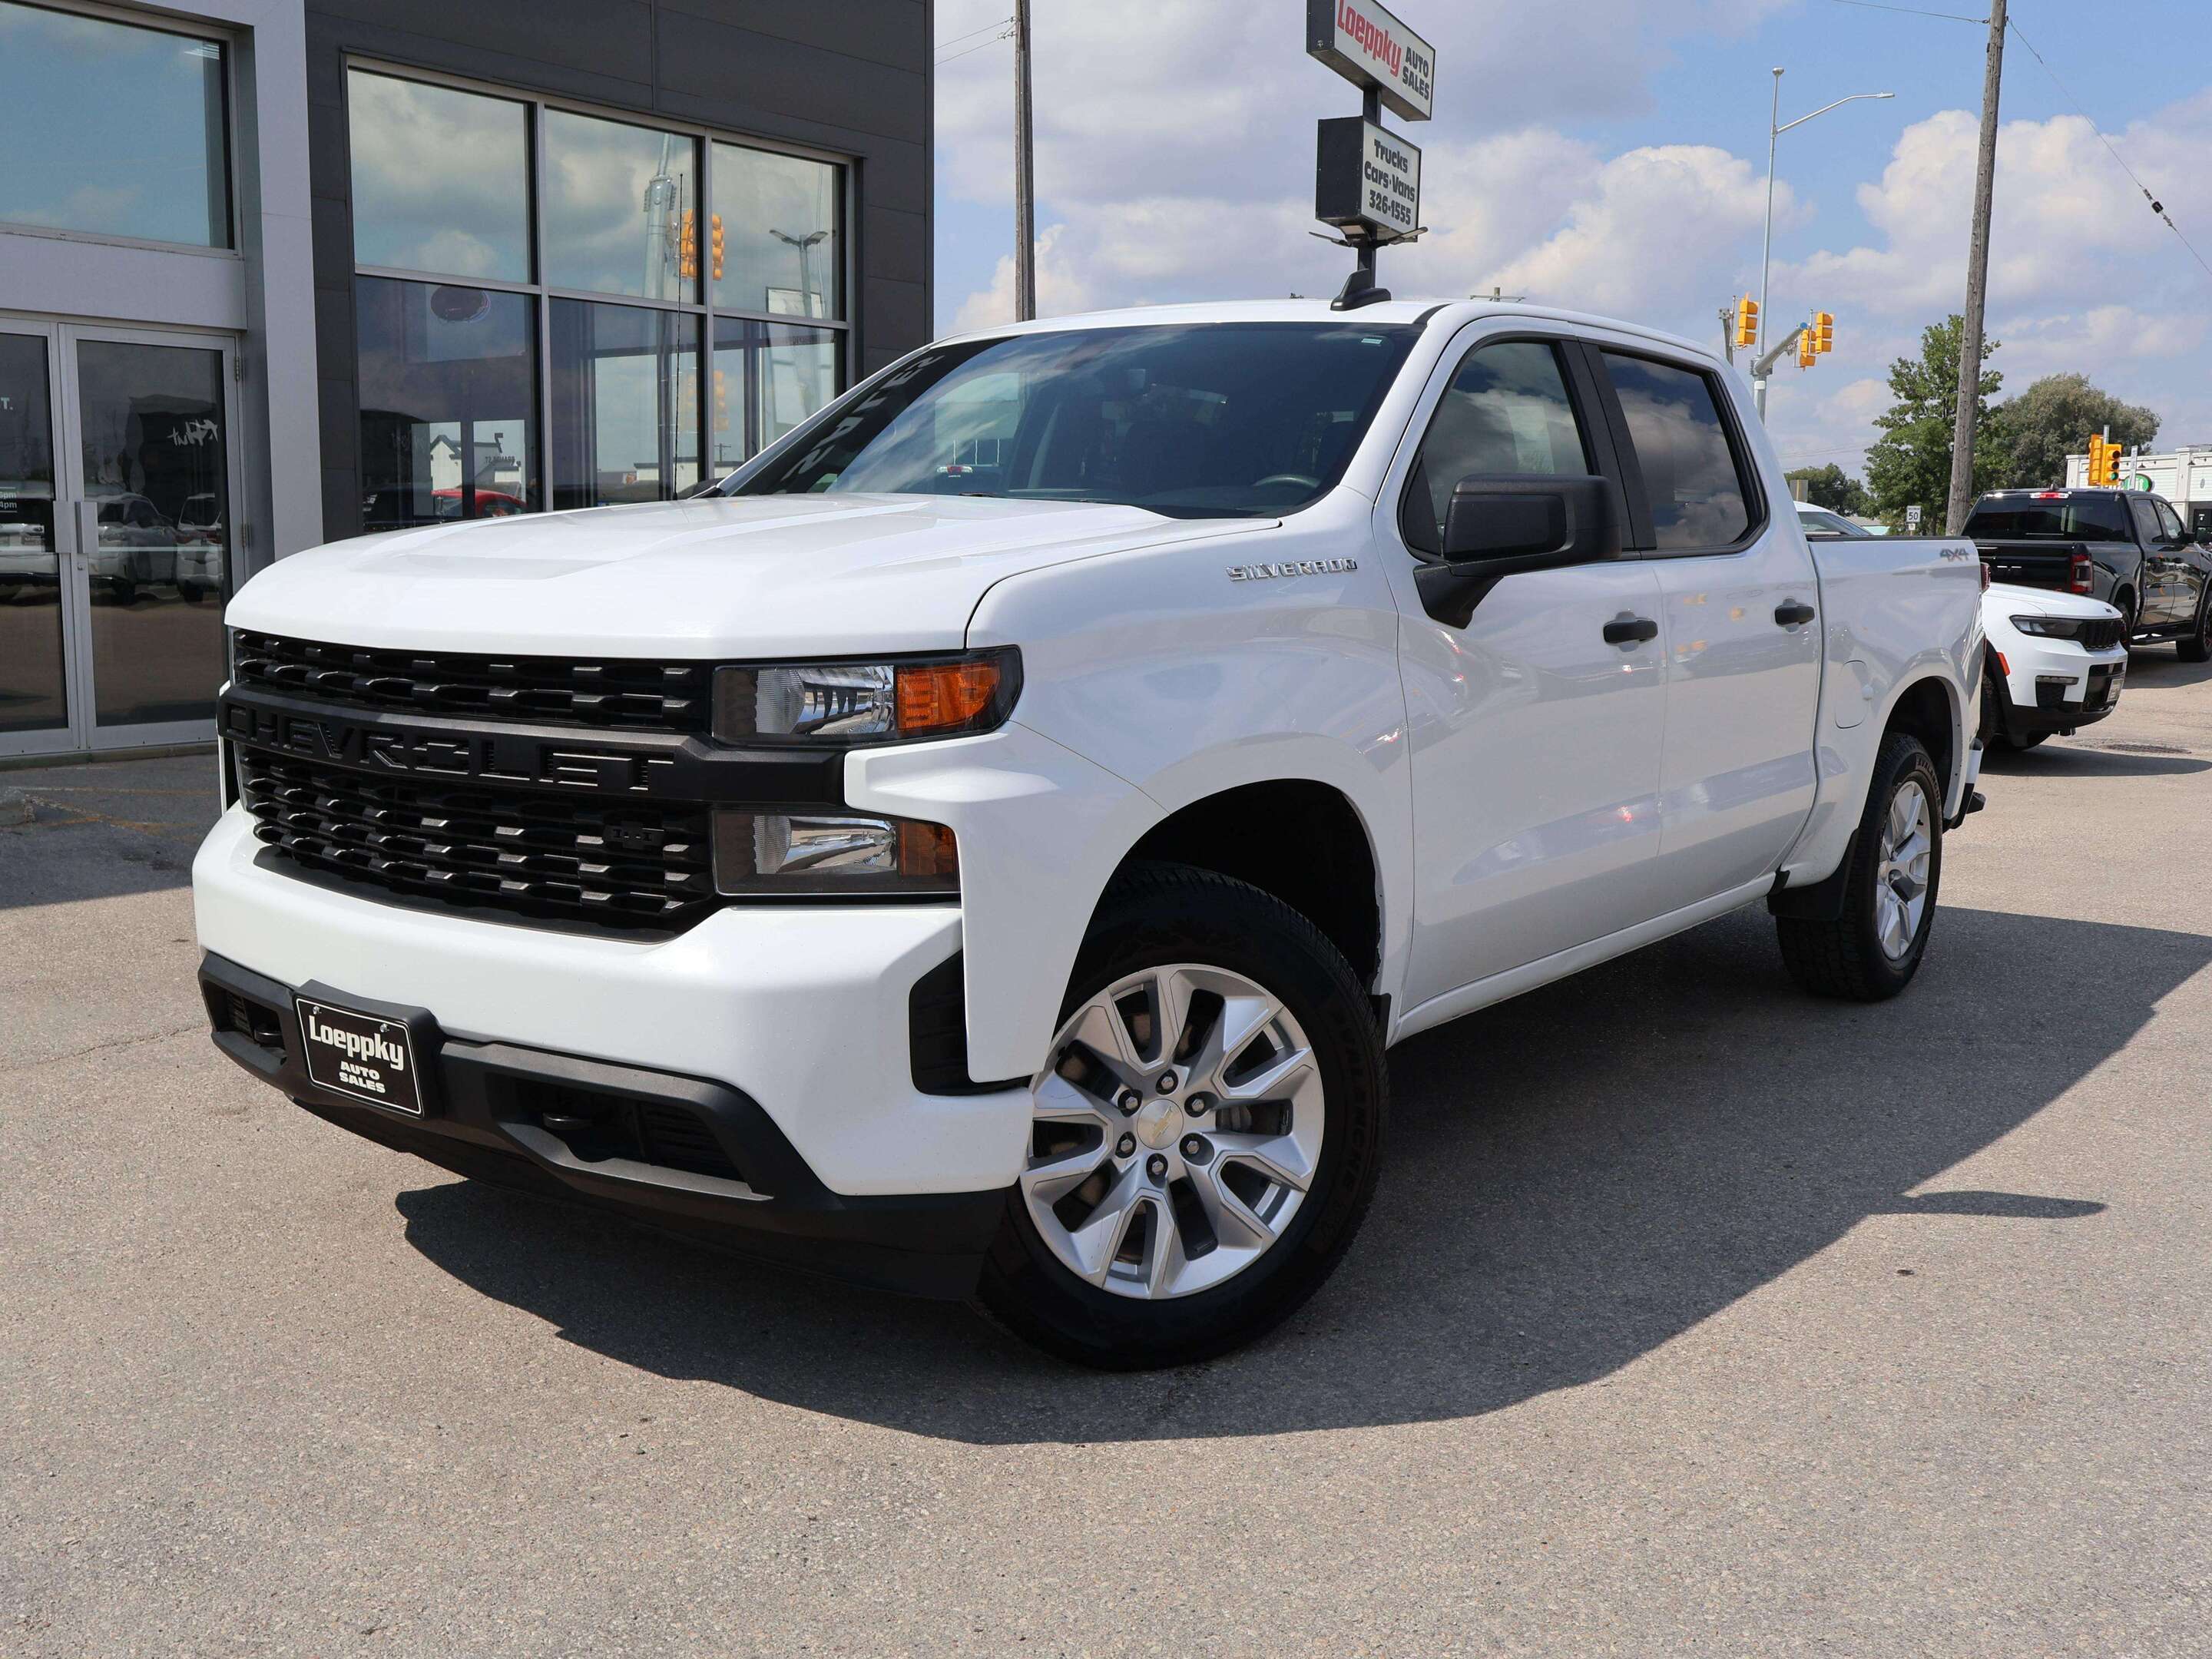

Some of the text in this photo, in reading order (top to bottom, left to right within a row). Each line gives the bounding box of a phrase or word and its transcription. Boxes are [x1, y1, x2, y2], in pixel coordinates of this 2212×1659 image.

[1337, 0, 1402, 78] Loeppky
[1405, 46, 1429, 78] AUTO
[1402, 66, 1430, 101] SALES
[1374, 138, 1408, 174] Trucks
[1909, 512, 1919, 520] 50
[1225, 557, 1358, 583] SILVERADO
[227, 702, 675, 791] CHEVROLET
[309, 1015, 405, 1071] Loeppky
[339, 1071, 386, 1094] SALES
[340, 1061, 380, 1081] AUTO
